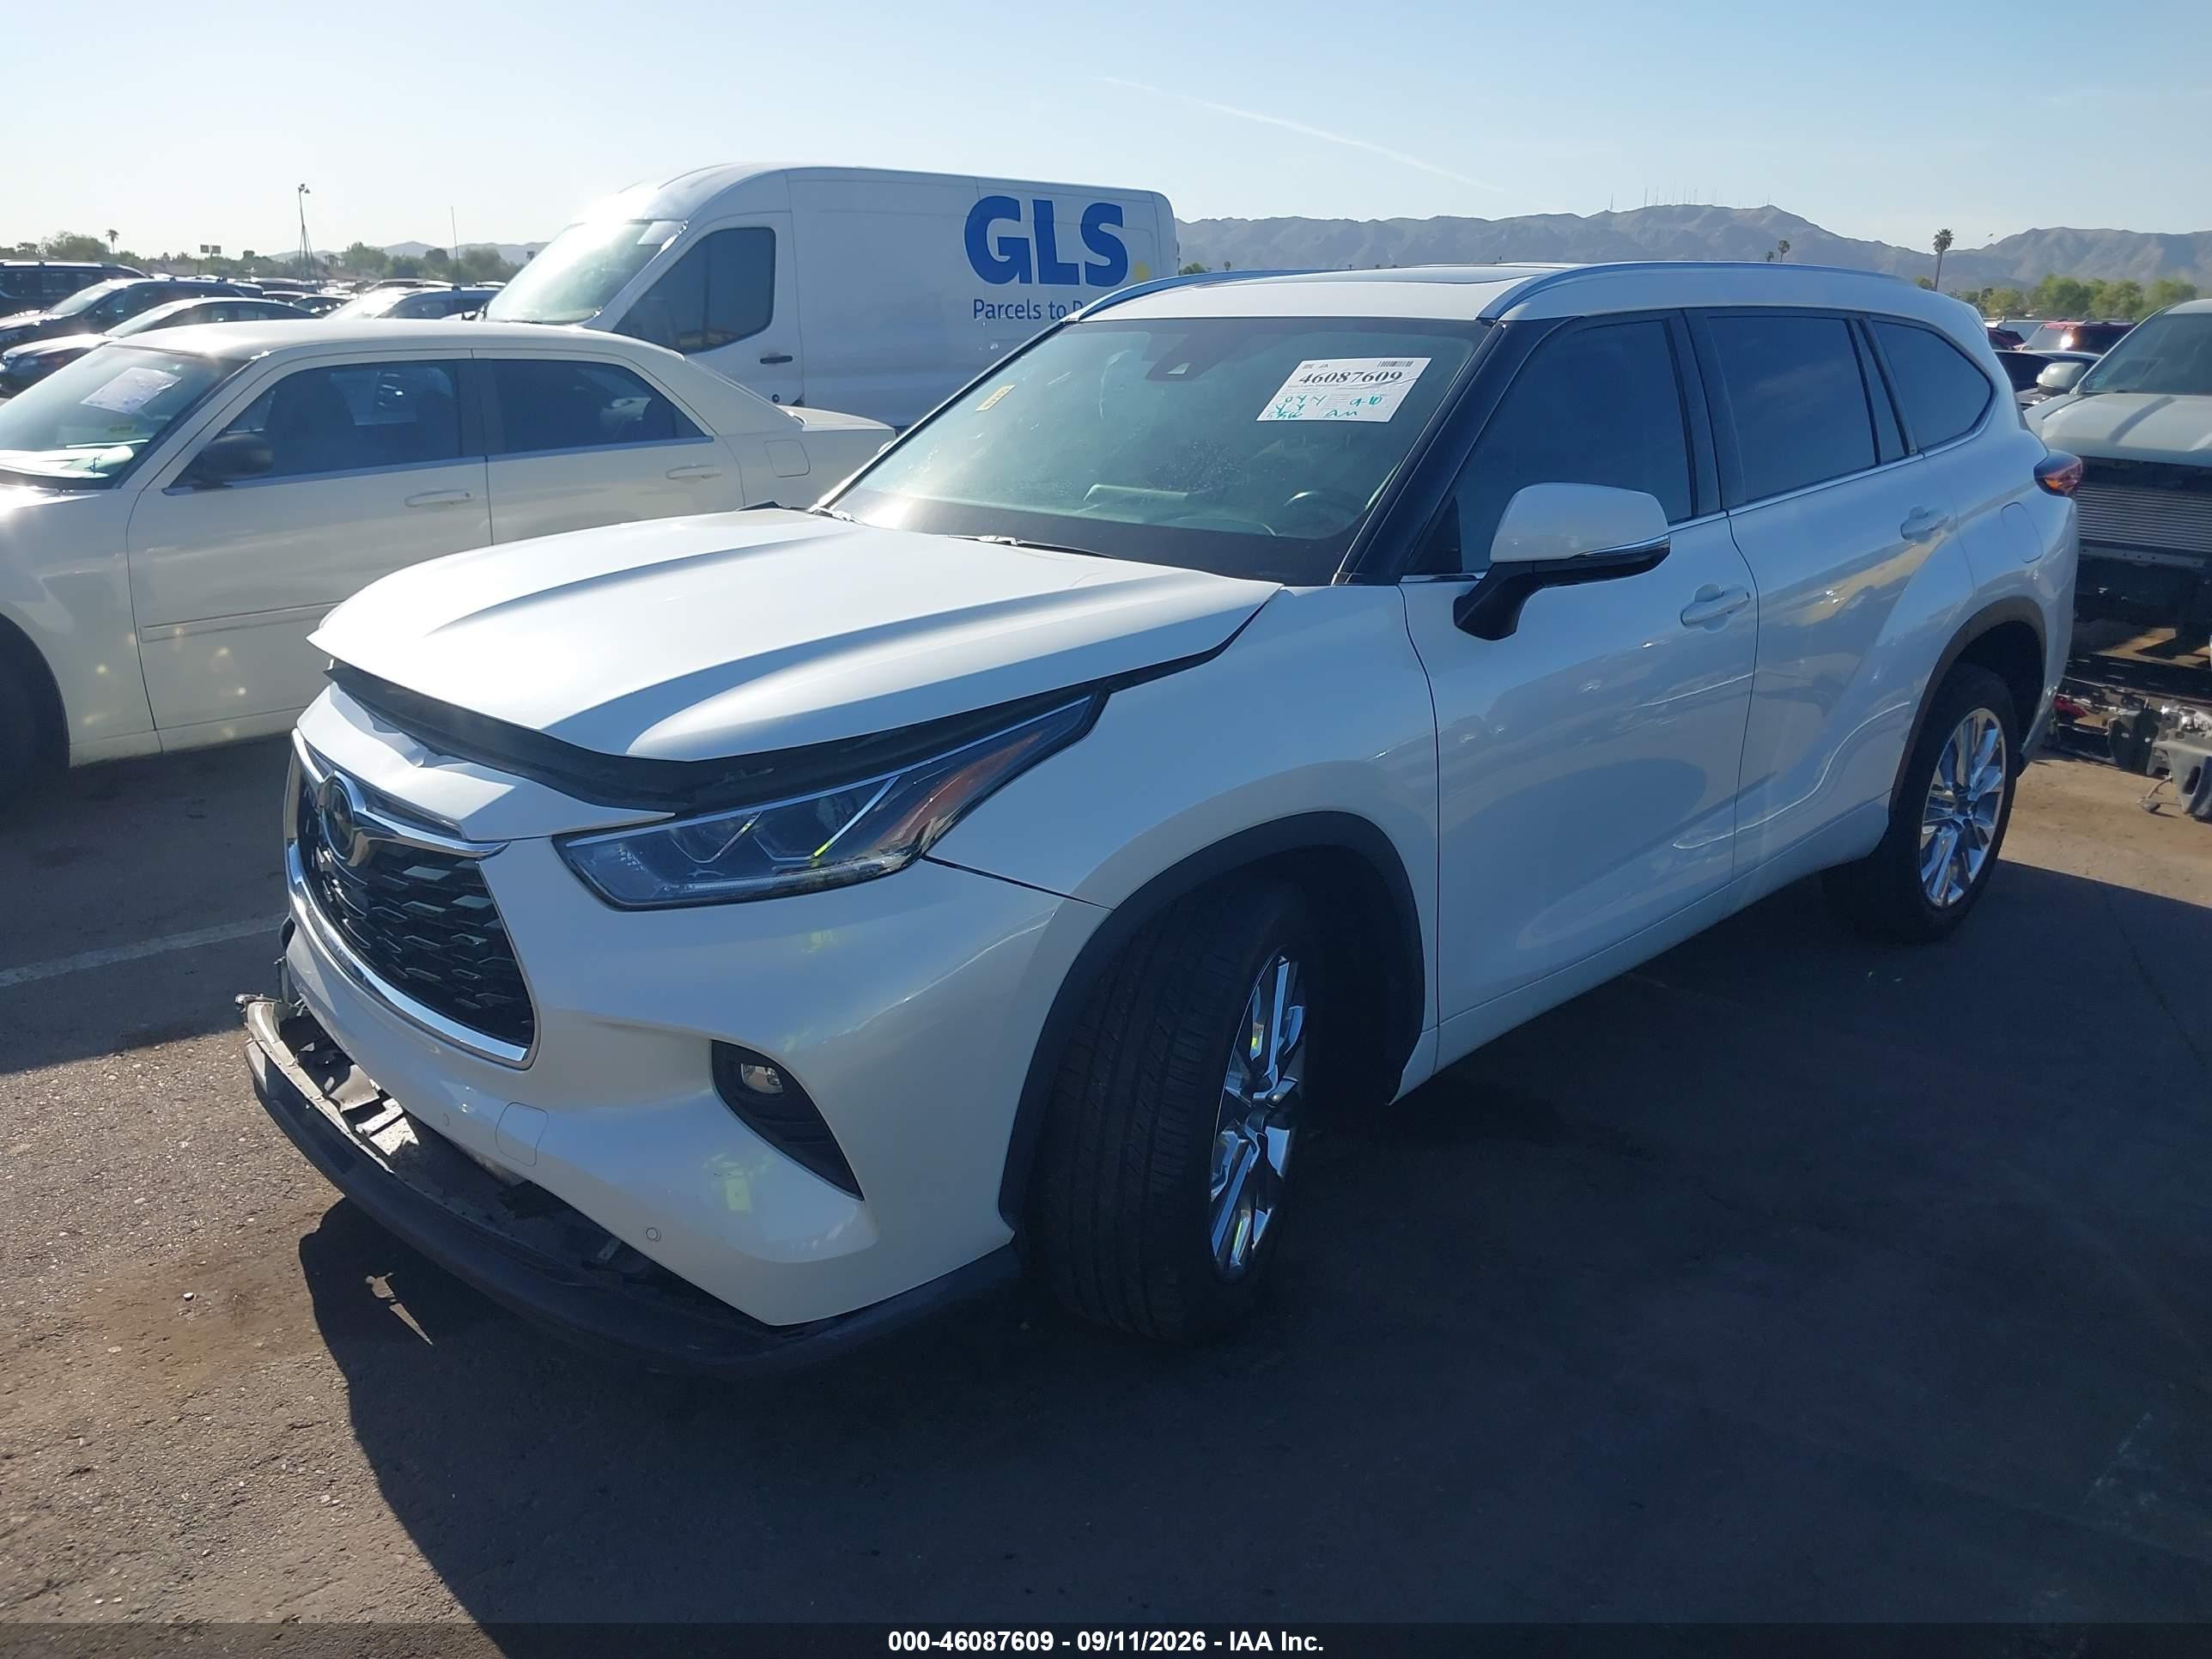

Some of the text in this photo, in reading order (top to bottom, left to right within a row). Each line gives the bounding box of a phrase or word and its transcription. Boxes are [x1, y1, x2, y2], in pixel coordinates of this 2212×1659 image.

[963, 196, 1128, 288] GLS
[973, 299, 1042, 320] Parcels
[1048, 301, 1066, 320] to
[1298, 370, 1403, 384] 46087609
